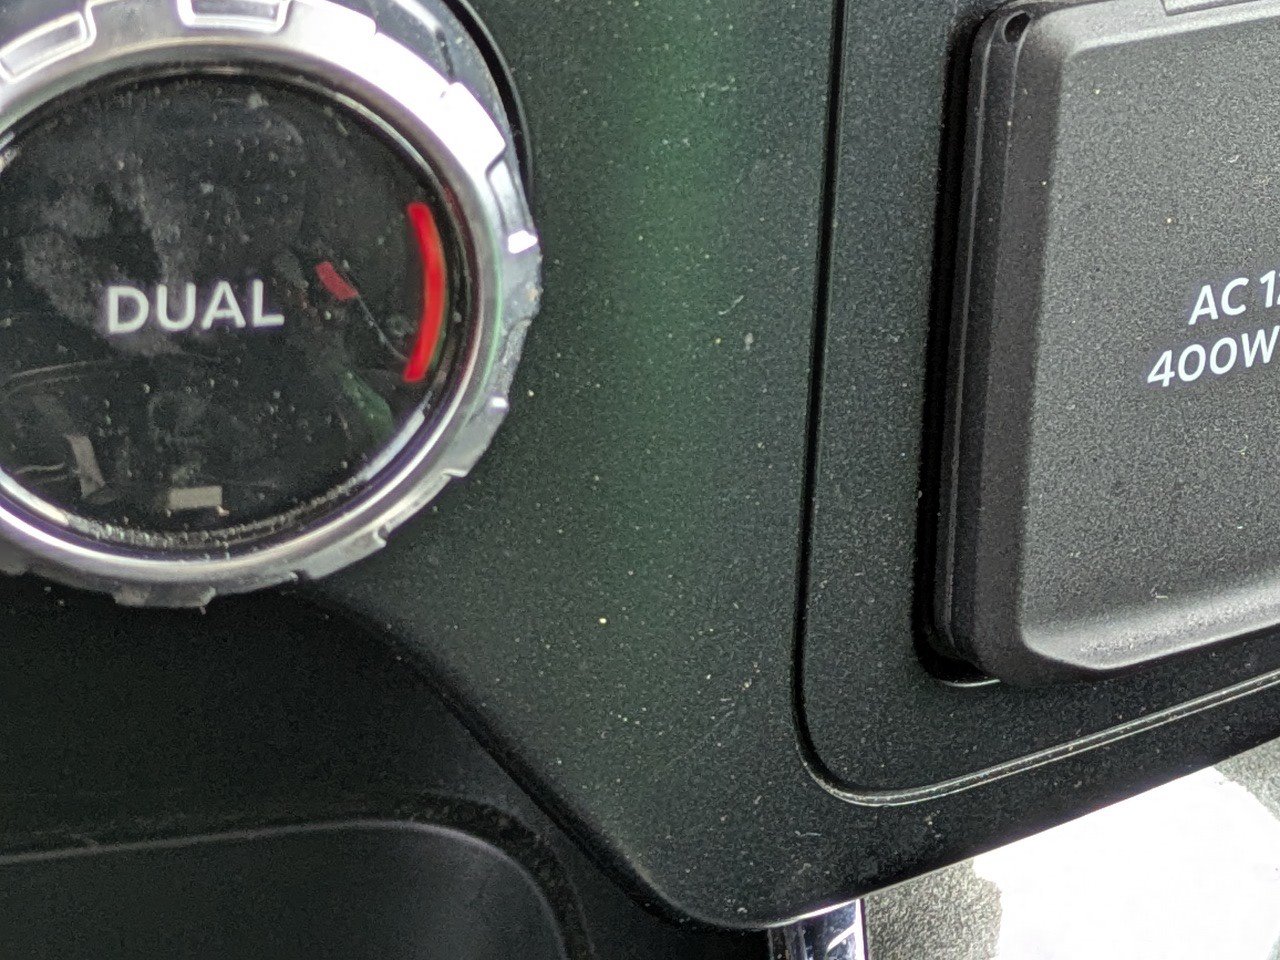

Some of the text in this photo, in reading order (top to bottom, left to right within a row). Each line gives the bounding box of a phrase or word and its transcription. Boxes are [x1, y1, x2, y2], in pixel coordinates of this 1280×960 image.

[106, 279, 285, 334] DUAL
[1187, 277, 1250, 326] AC
[1146, 324, 1280, 388] 400W
